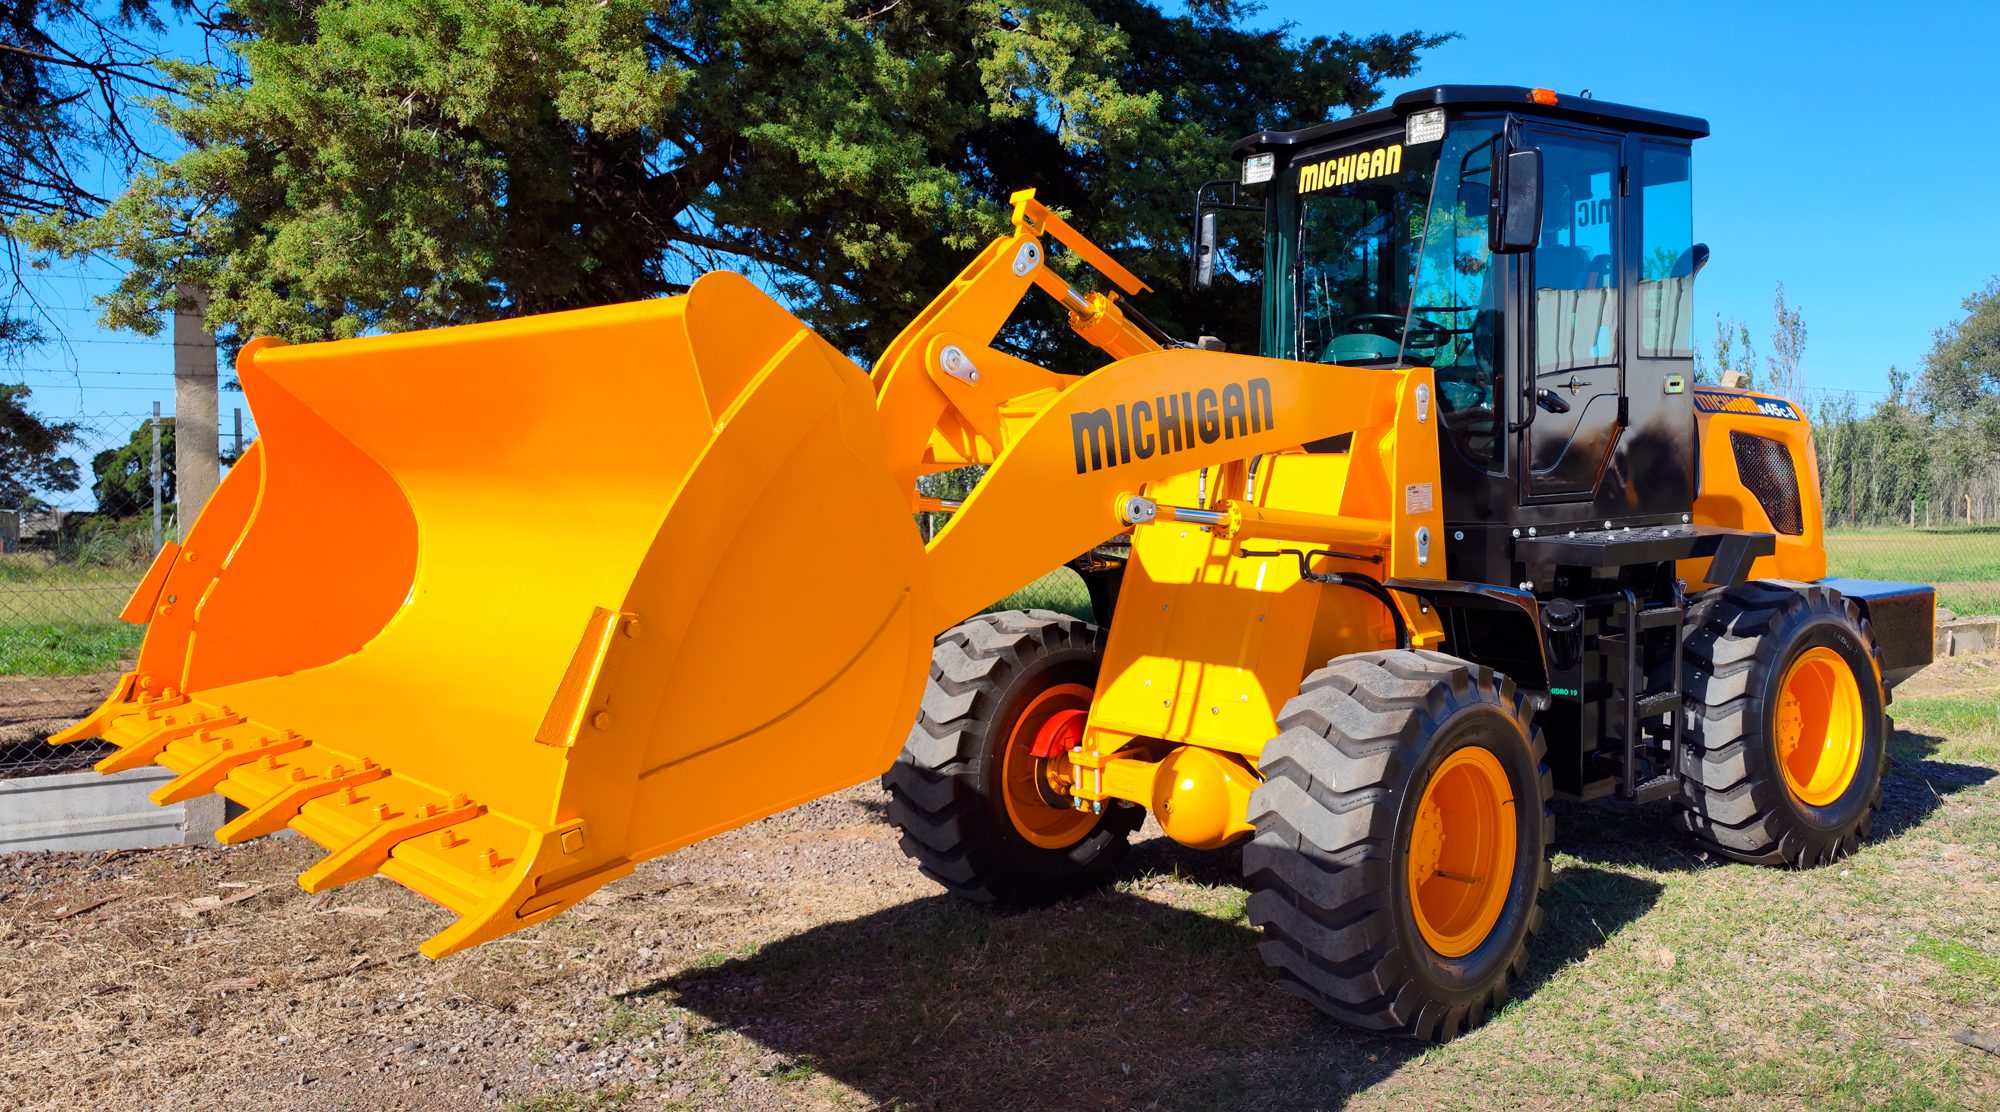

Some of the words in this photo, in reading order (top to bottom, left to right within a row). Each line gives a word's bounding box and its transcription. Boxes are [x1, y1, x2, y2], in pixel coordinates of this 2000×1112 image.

[1299, 144, 1402, 194] MICHIGAN
[1695, 394, 1761, 414] MICHIGAN
[1071, 377, 1274, 475] MICHIGAN
[1550, 687, 1569, 696] HIDRO
[1570, 689, 1578, 697] 19
